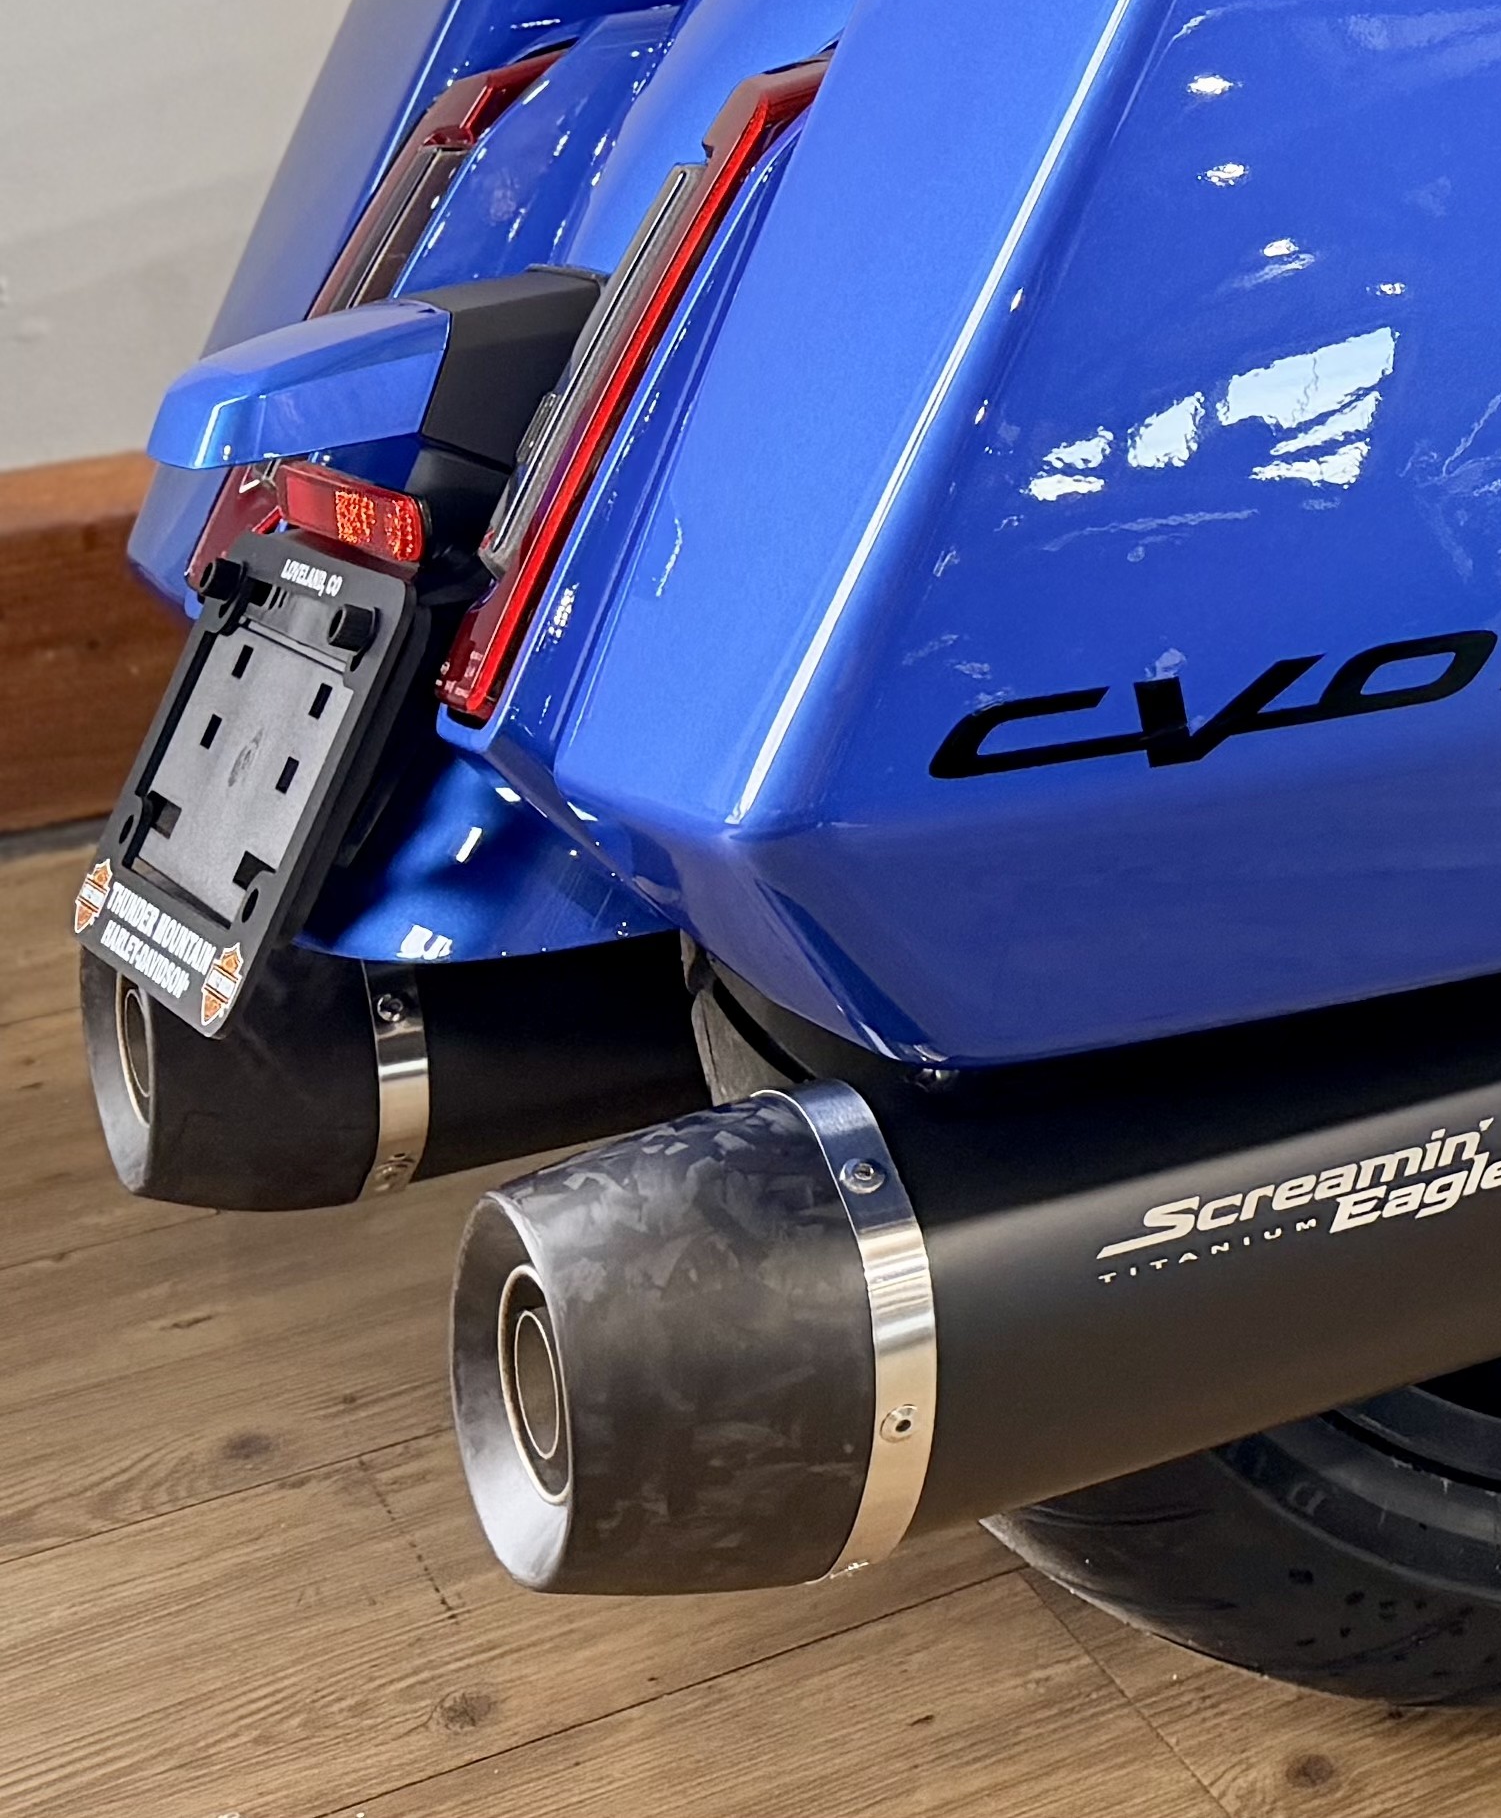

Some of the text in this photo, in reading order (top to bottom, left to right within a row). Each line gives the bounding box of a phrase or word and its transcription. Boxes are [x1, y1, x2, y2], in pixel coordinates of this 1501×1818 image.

[281, 559, 343, 597] LOVELAND, CO
[101, 919, 189, 998] HARLEY-DAVIDSON
[107, 881, 160, 937] THUNDER
[152, 913, 217, 976] MOUNTAIN
[1096, 1117, 1495, 1260] Screamin'
[1098, 1218, 1317, 1283] TITANIUM
